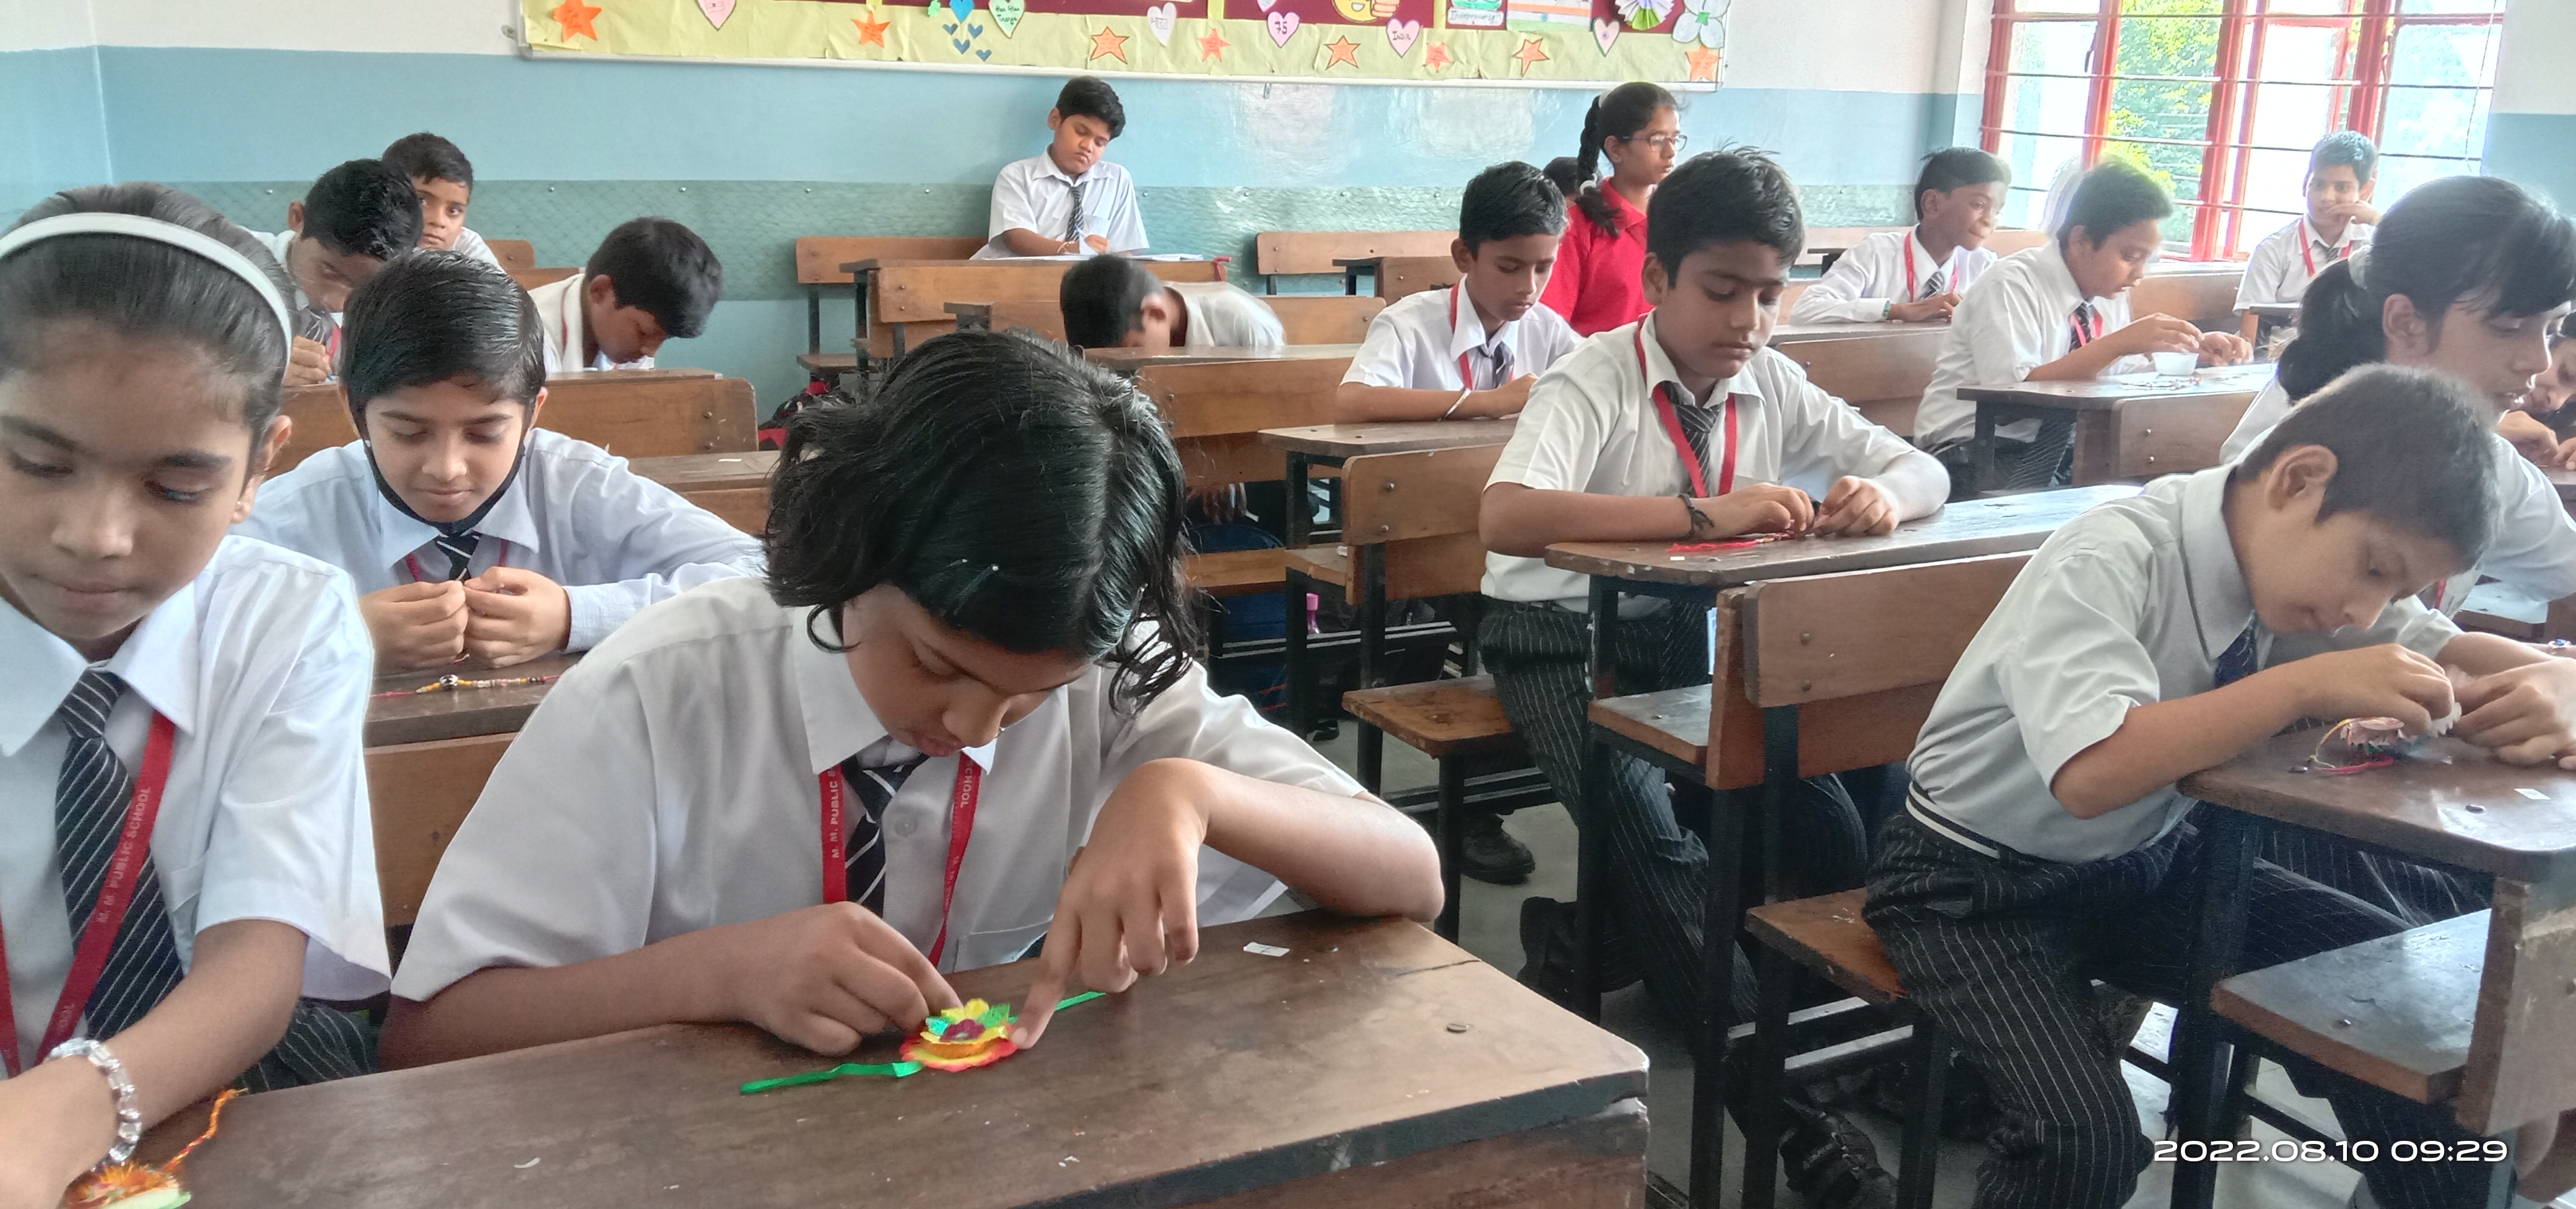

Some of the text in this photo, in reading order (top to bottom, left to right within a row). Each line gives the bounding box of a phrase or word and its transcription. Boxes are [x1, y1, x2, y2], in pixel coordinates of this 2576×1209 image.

[1274, 21, 1287, 35] 75
[829, 780, 839, 825] PUBLIC
[110, 840, 133, 889] PUBLIC
[128, 786, 151, 839] SCHOOL
